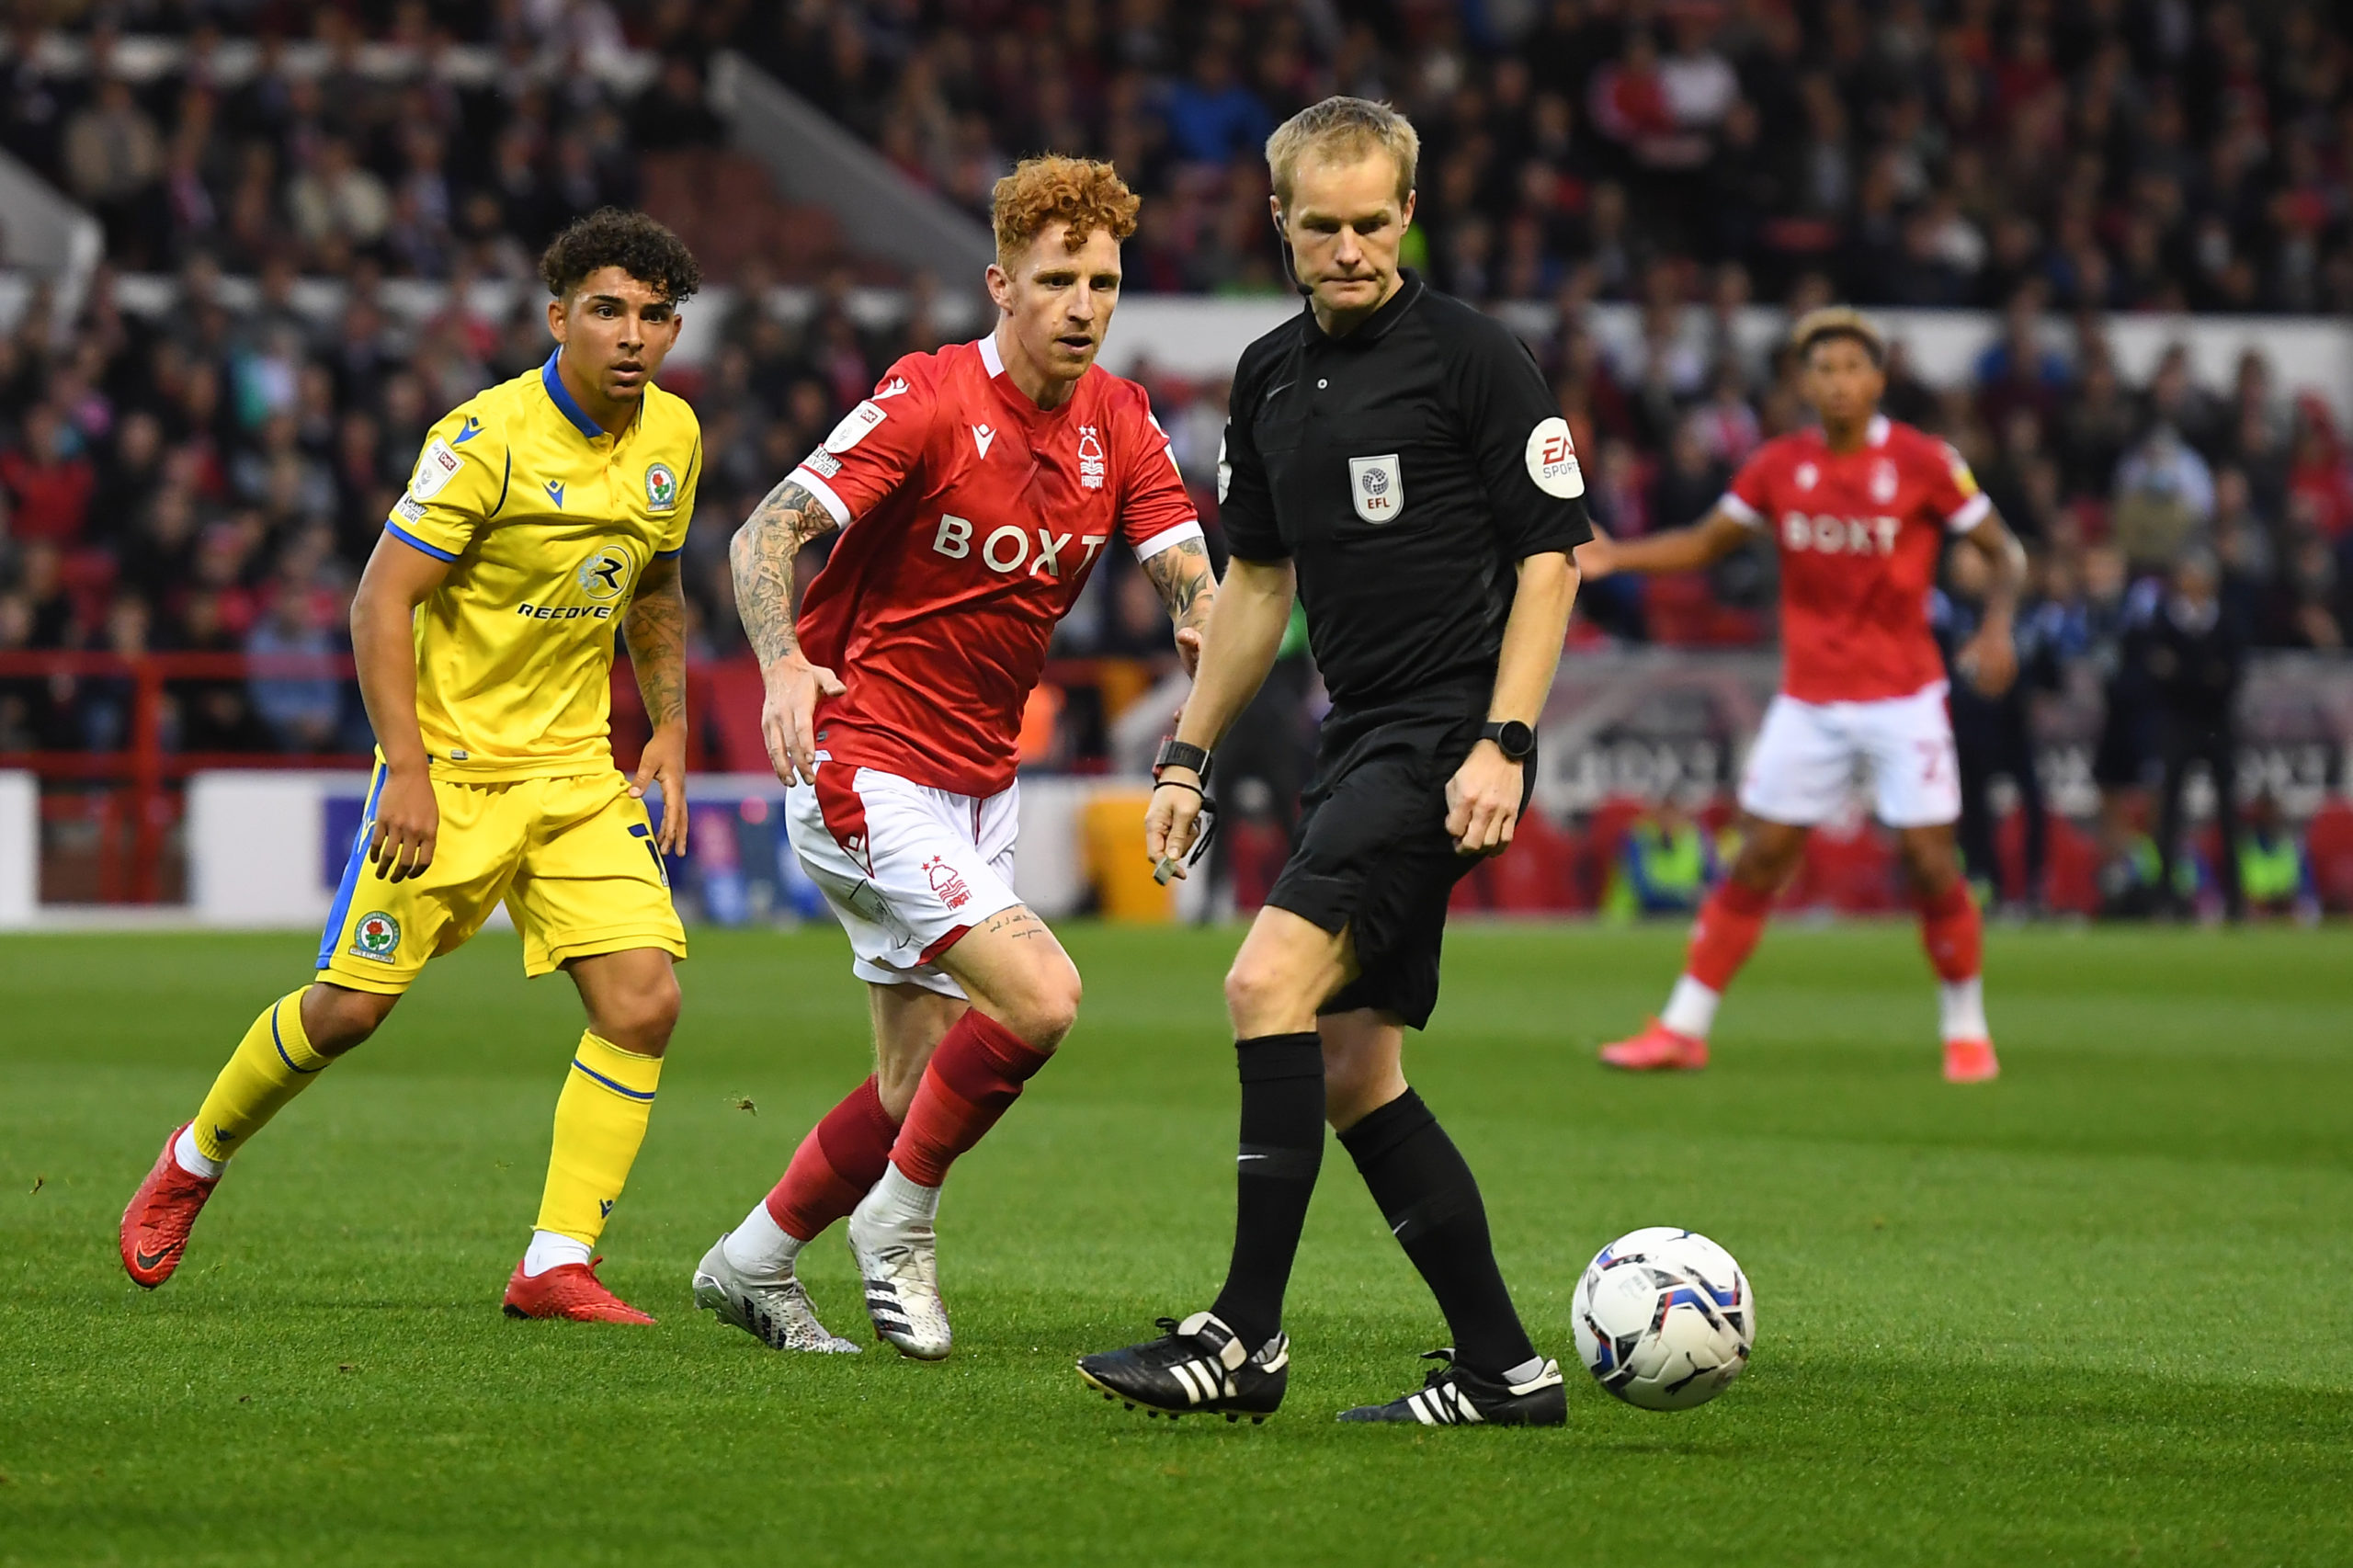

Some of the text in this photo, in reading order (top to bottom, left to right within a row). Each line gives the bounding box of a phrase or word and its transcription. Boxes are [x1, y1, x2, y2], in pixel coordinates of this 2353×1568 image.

[439, 451, 456, 471] bet
[1542, 436, 1576, 465] EA
[1368, 497, 1390, 509] EFL
[932, 513, 1107, 577] BOXT
[1783, 510, 1902, 556] BOXT
